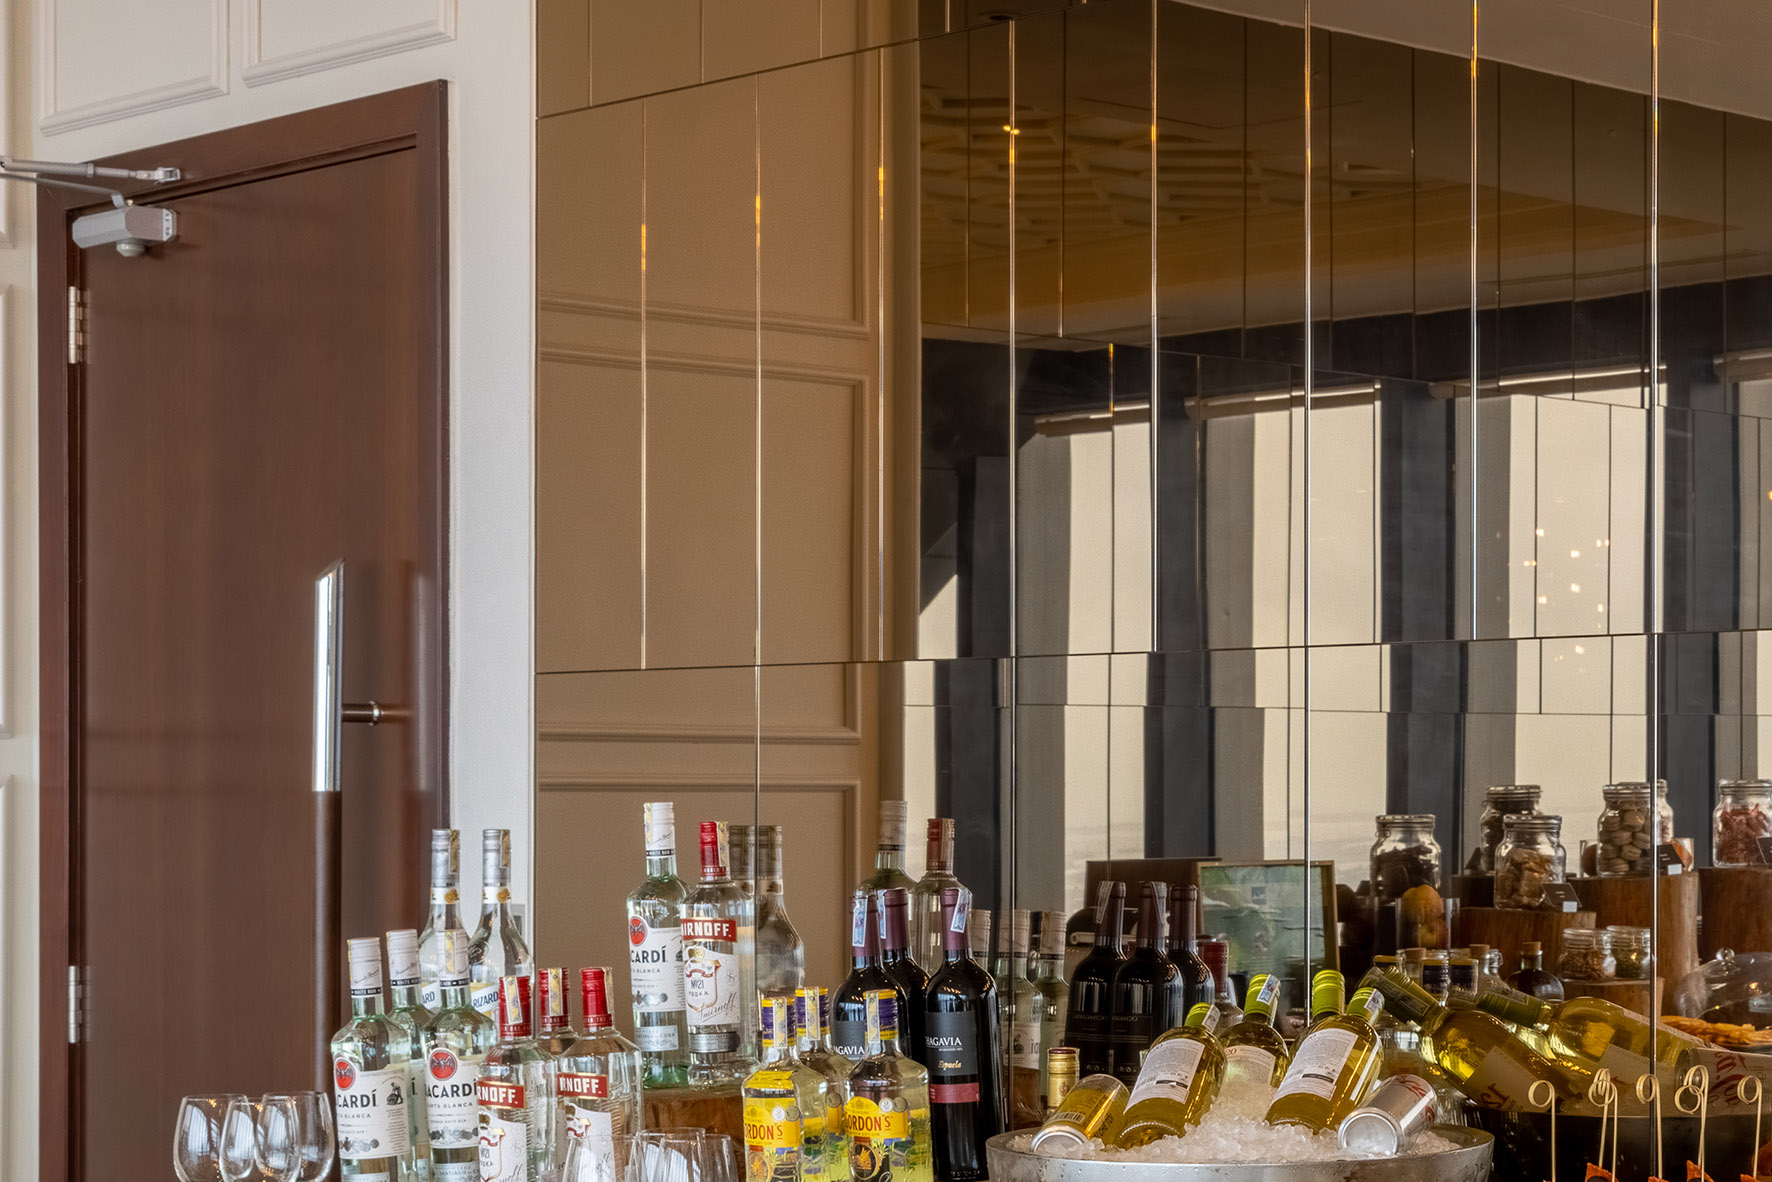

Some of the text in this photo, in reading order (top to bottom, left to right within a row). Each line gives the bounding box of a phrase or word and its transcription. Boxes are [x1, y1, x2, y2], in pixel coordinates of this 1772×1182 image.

[631, 945, 667, 964] CARDÍ
[473, 990, 499, 1008] RIZARD
[926, 1036, 962, 1046] HAGAVIA
[833, 1046, 865, 1055] AGAVIA
[1225, 1048, 1237, 1056] 20
[336, 1089, 378, 1109] CARDÍ
[477, 1086, 516, 1104] RNOFF
[846, 1114, 891, 1132] ORDON'S
